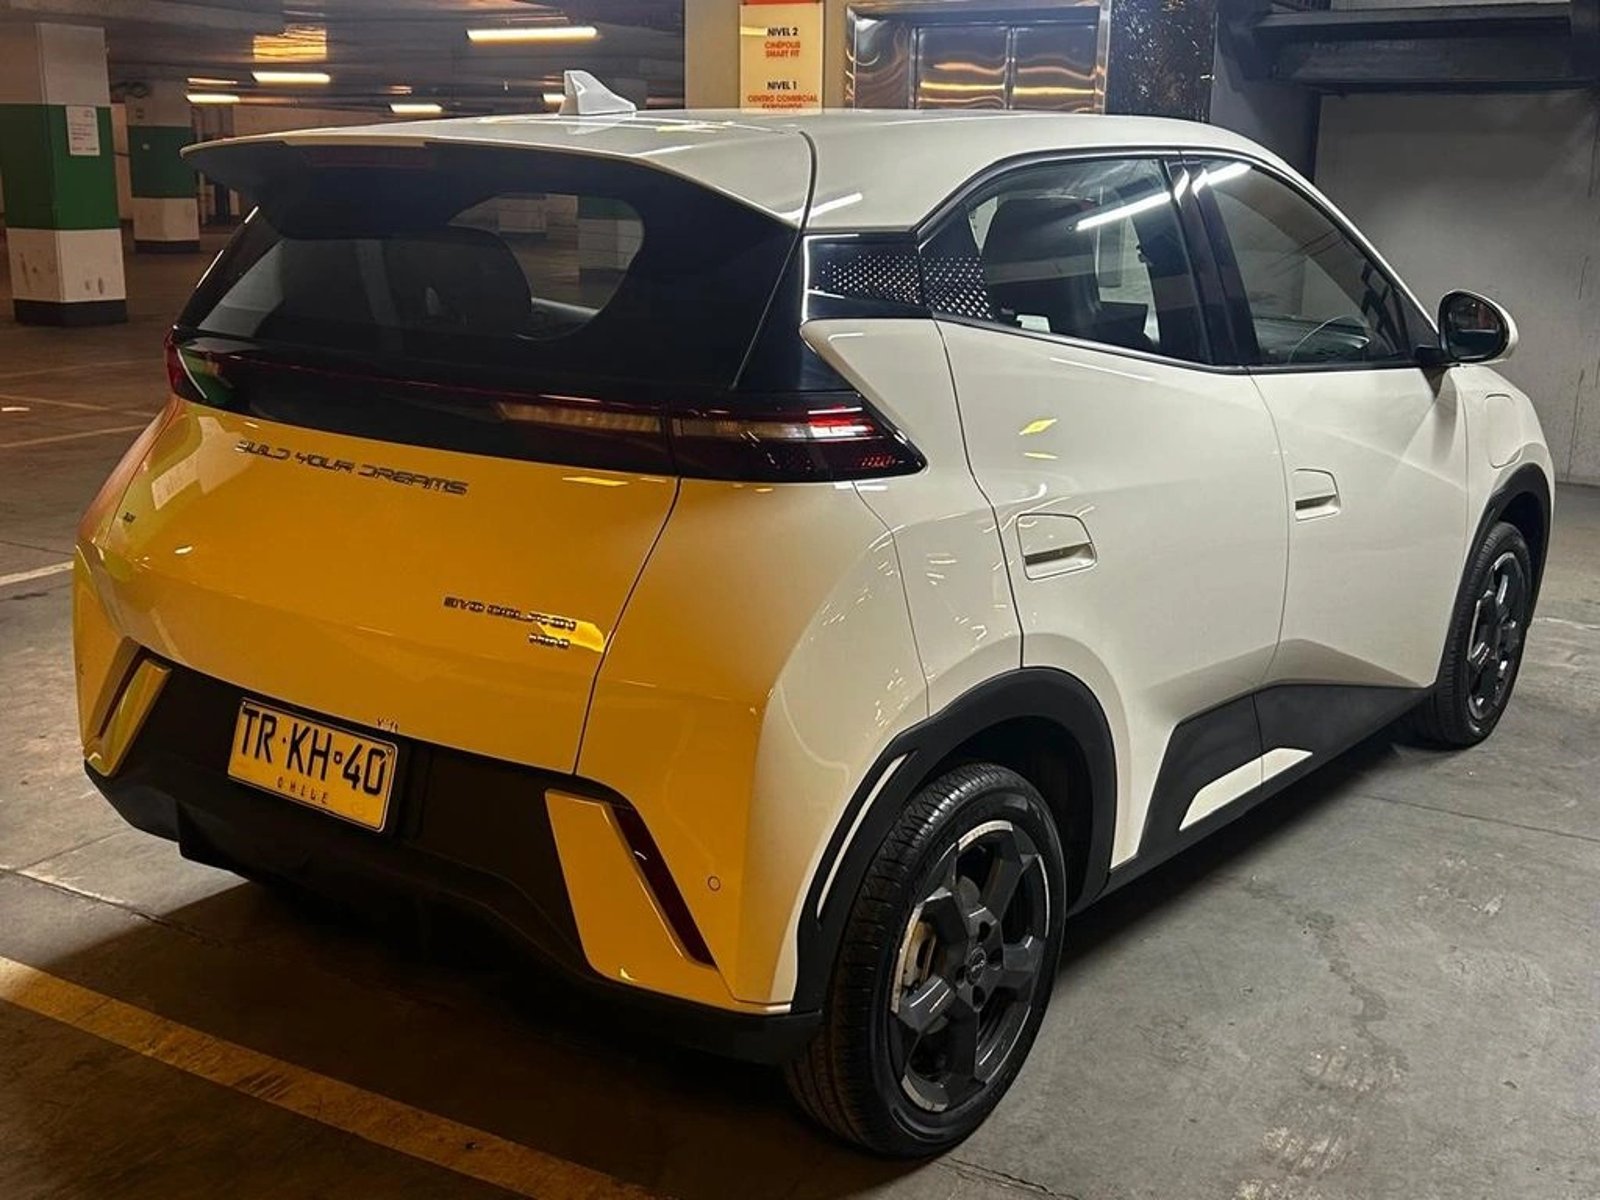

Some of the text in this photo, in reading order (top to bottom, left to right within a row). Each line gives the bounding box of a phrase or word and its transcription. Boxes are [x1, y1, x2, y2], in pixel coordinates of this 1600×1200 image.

[767, 27, 798, 36] NIVEL 2
[767, 81, 790, 90] NIVEL
[295, 452, 354, 474] YOUR
[358, 465, 469, 495] DREAMS
[277, 777, 328, 804] CHILE
